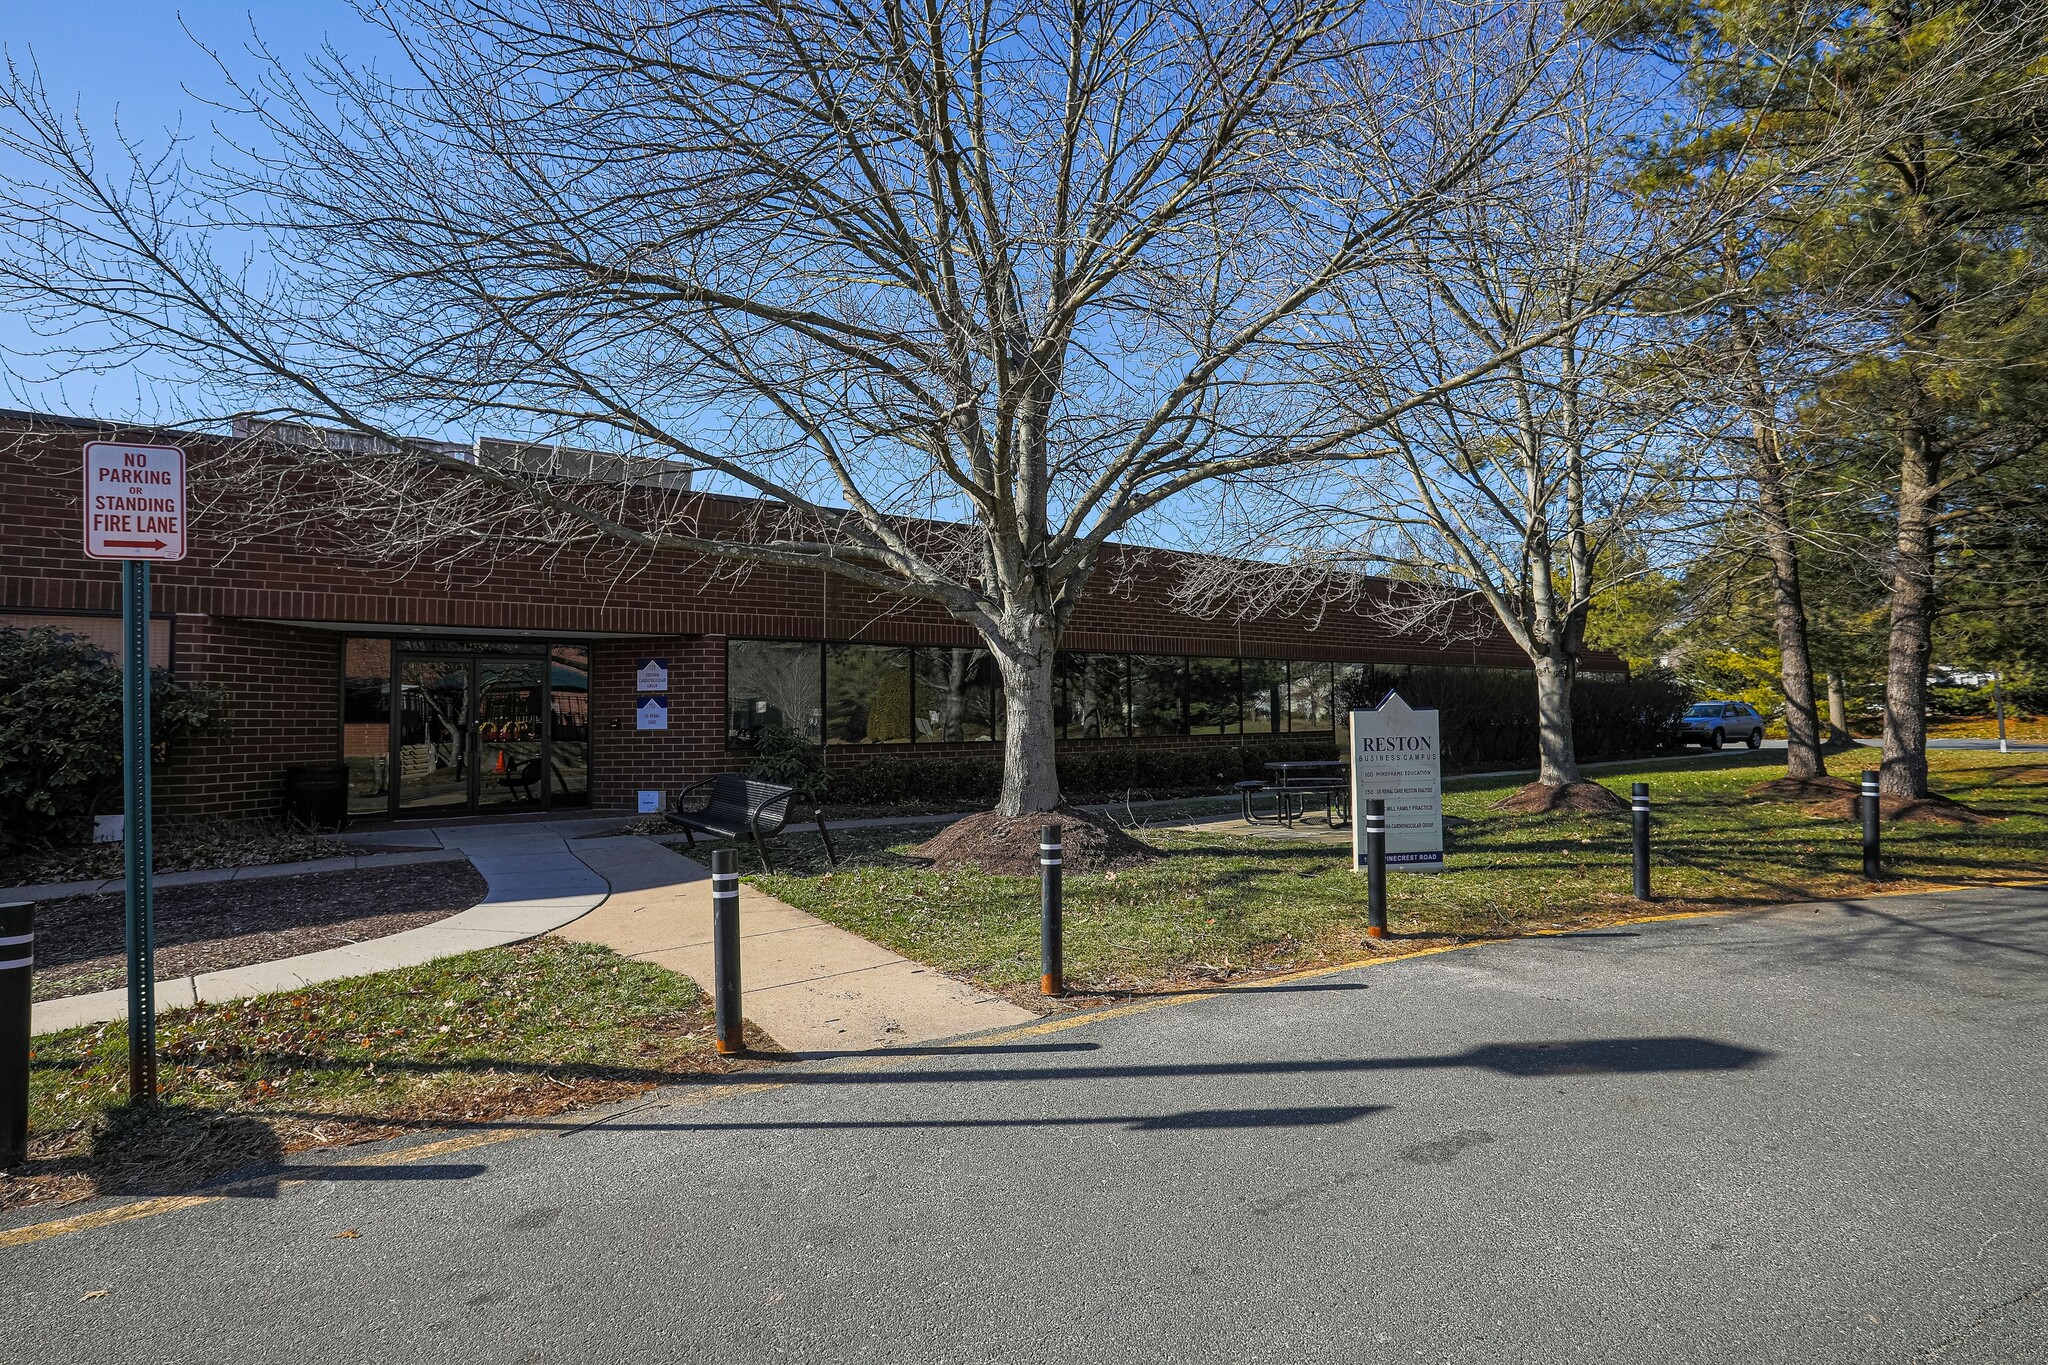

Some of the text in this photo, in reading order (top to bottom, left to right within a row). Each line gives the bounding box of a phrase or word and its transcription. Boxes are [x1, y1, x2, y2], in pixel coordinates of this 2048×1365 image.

[124, 452, 147, 468] NO
[99, 467, 172, 485] PARKING
[129, 486, 143, 494] OR
[95, 496, 175, 513] STANDING
[93, 514, 178, 534] FIRE LANE
[1363, 736, 1431, 752] RESTON
[1403, 753, 1437, 761] CAMPUS
